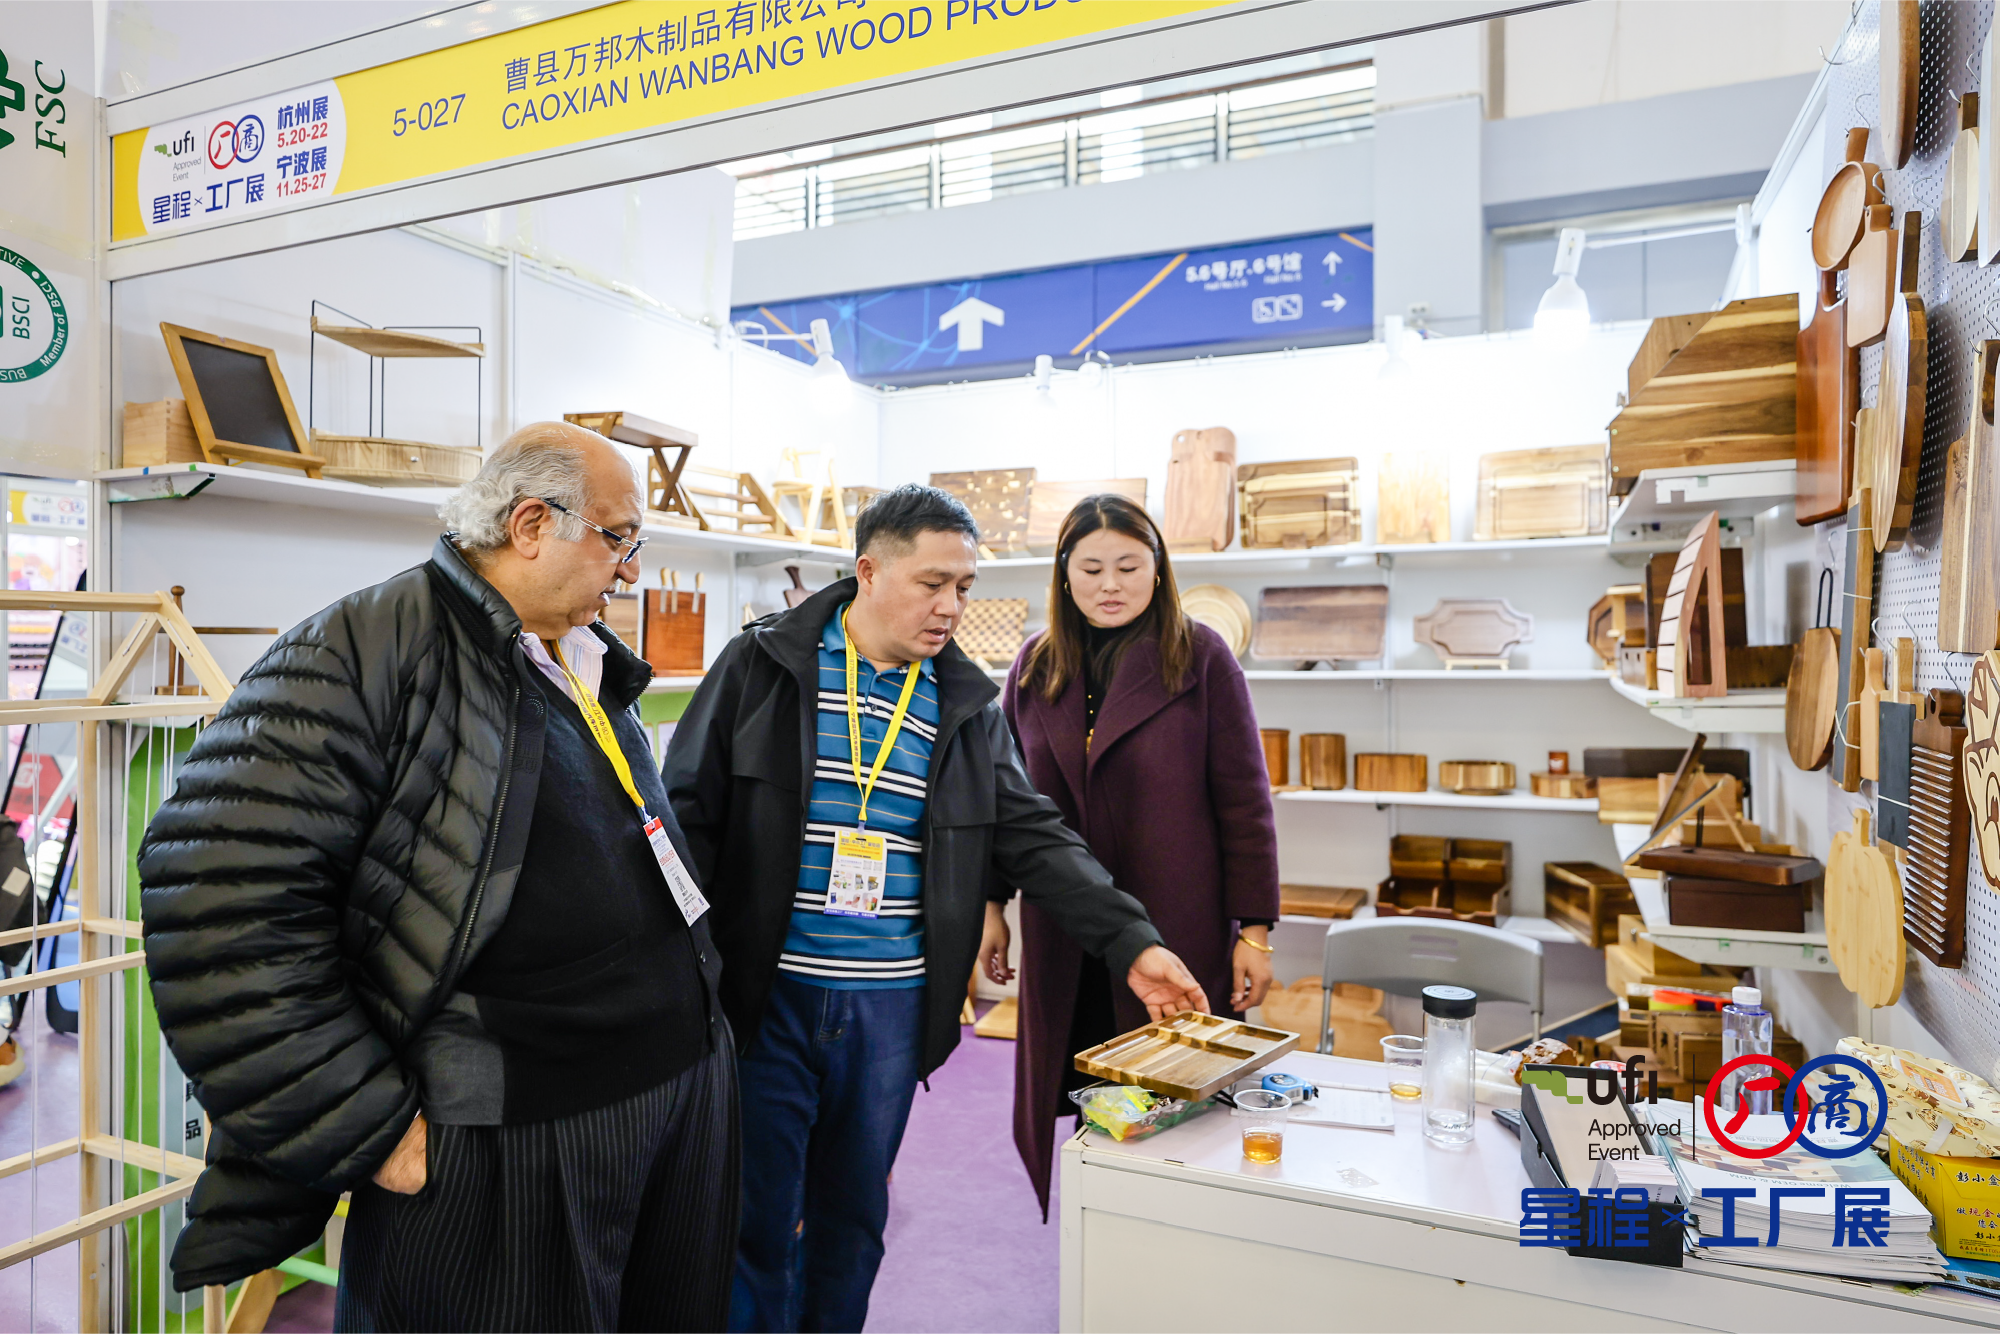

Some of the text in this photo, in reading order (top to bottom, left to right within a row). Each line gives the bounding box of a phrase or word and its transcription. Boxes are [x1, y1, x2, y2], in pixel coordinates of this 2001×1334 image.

[501, 77, 629, 130] CAOXIAN
[639, 36, 804, 100] WANBANG
[816, 6, 932, 58] WOOD
[35, 60, 66, 158] FSC
[277, 95, 329, 130] 杭州展
[392, 94, 466, 137] 5-027
[172, 131, 195, 156] ufi
[277, 122, 328, 148] 5.20-22
[173, 156, 202, 171] Approved
[173, 171, 189, 182] Event
[276, 146, 328, 179] 宁波展
[276, 173, 327, 198] 11.25-27
[12, 296, 30, 340] BSCI
[40, 280, 66, 367] Member of BSCI
